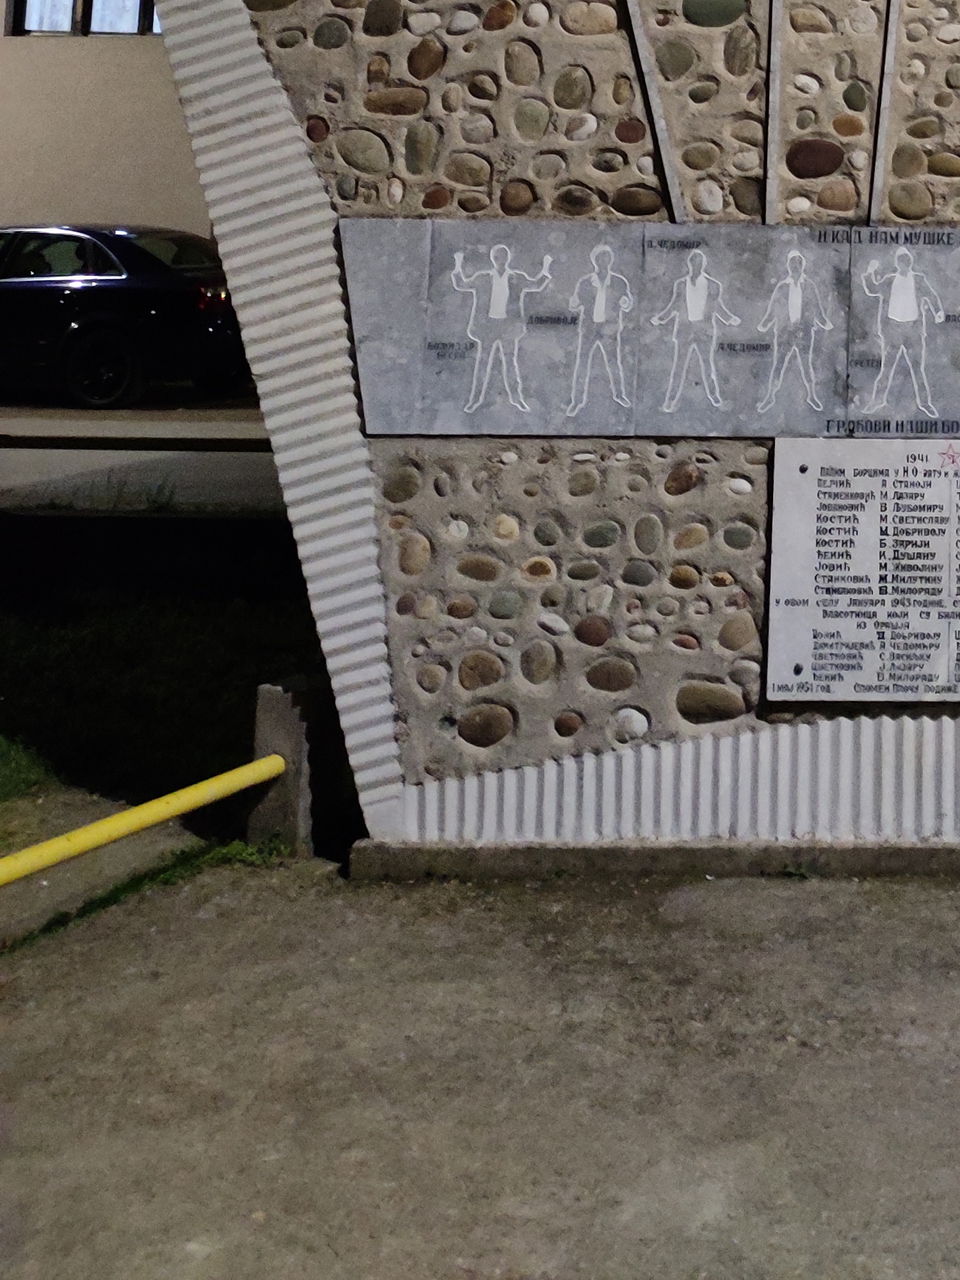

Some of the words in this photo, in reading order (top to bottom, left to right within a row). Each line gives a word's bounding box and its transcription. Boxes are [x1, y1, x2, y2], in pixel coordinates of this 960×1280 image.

[869, 232, 899, 245] НАМ
[902, 232, 954, 246] МУШКЕ
[906, 455, 928, 463] 1941
